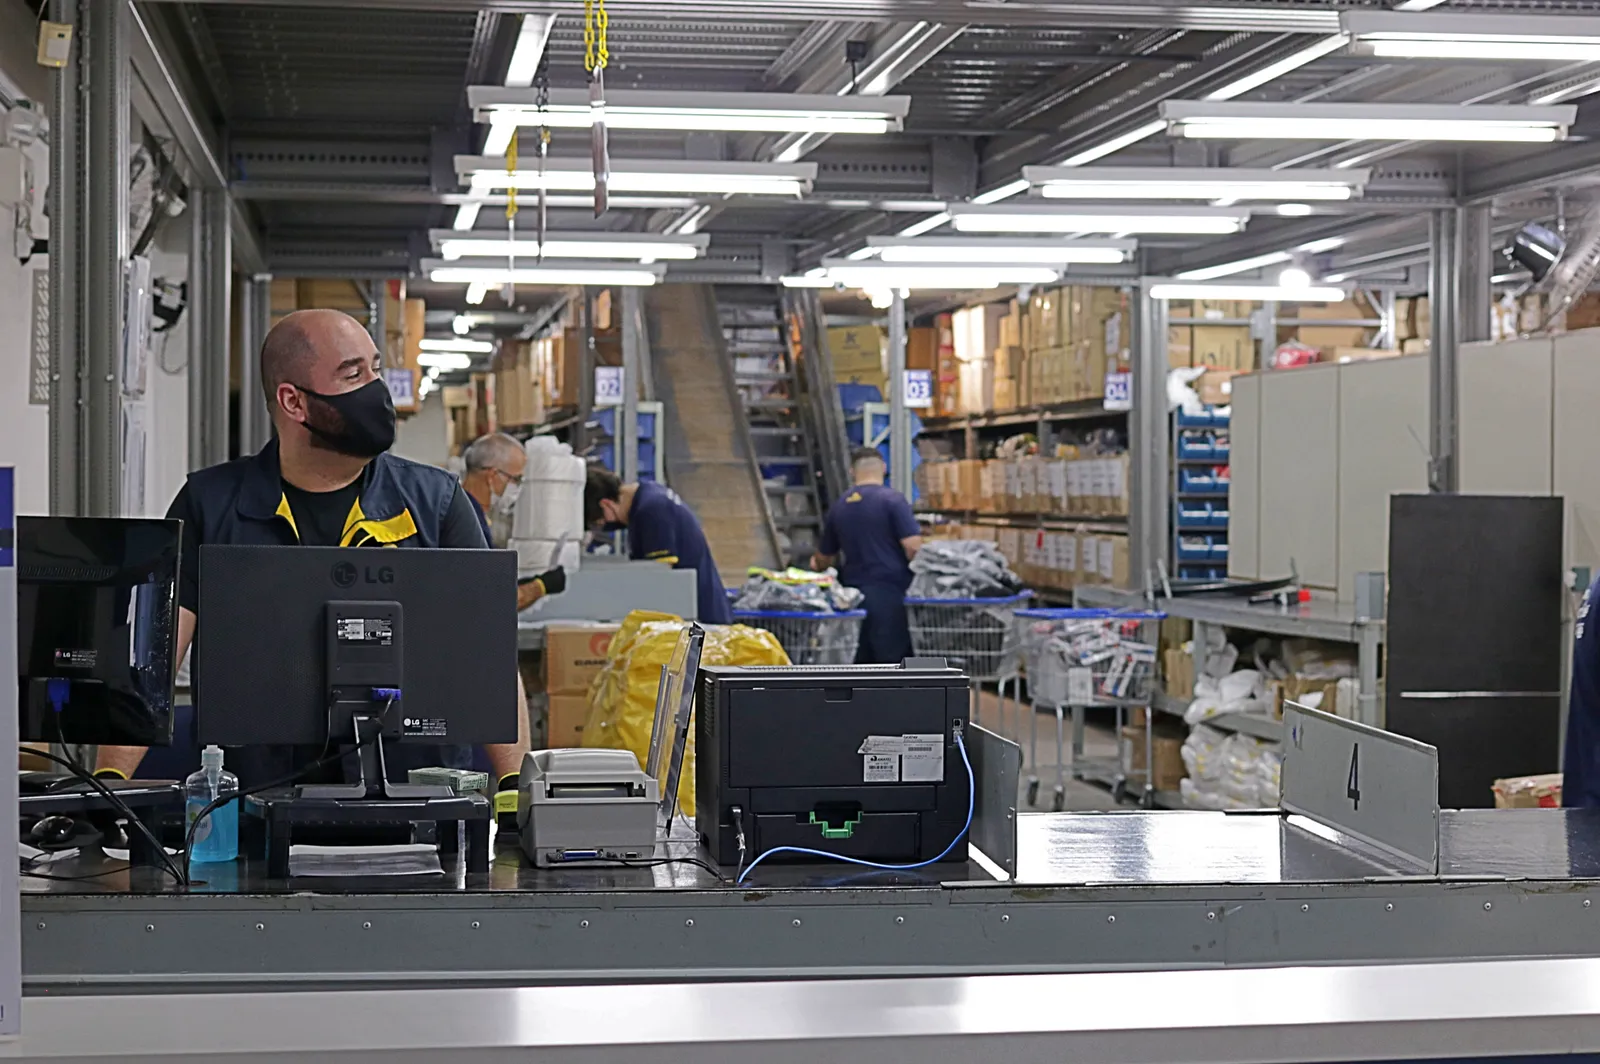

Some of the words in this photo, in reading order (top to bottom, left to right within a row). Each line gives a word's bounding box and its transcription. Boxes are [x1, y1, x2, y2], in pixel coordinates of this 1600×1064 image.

[390, 380, 410, 397] 01
[597, 380, 618, 396] 02
[908, 381, 929, 398] 03
[1105, 383, 1126, 399] 04
[364, 566, 395, 584] LG
[1346, 743, 1360, 811] 4
